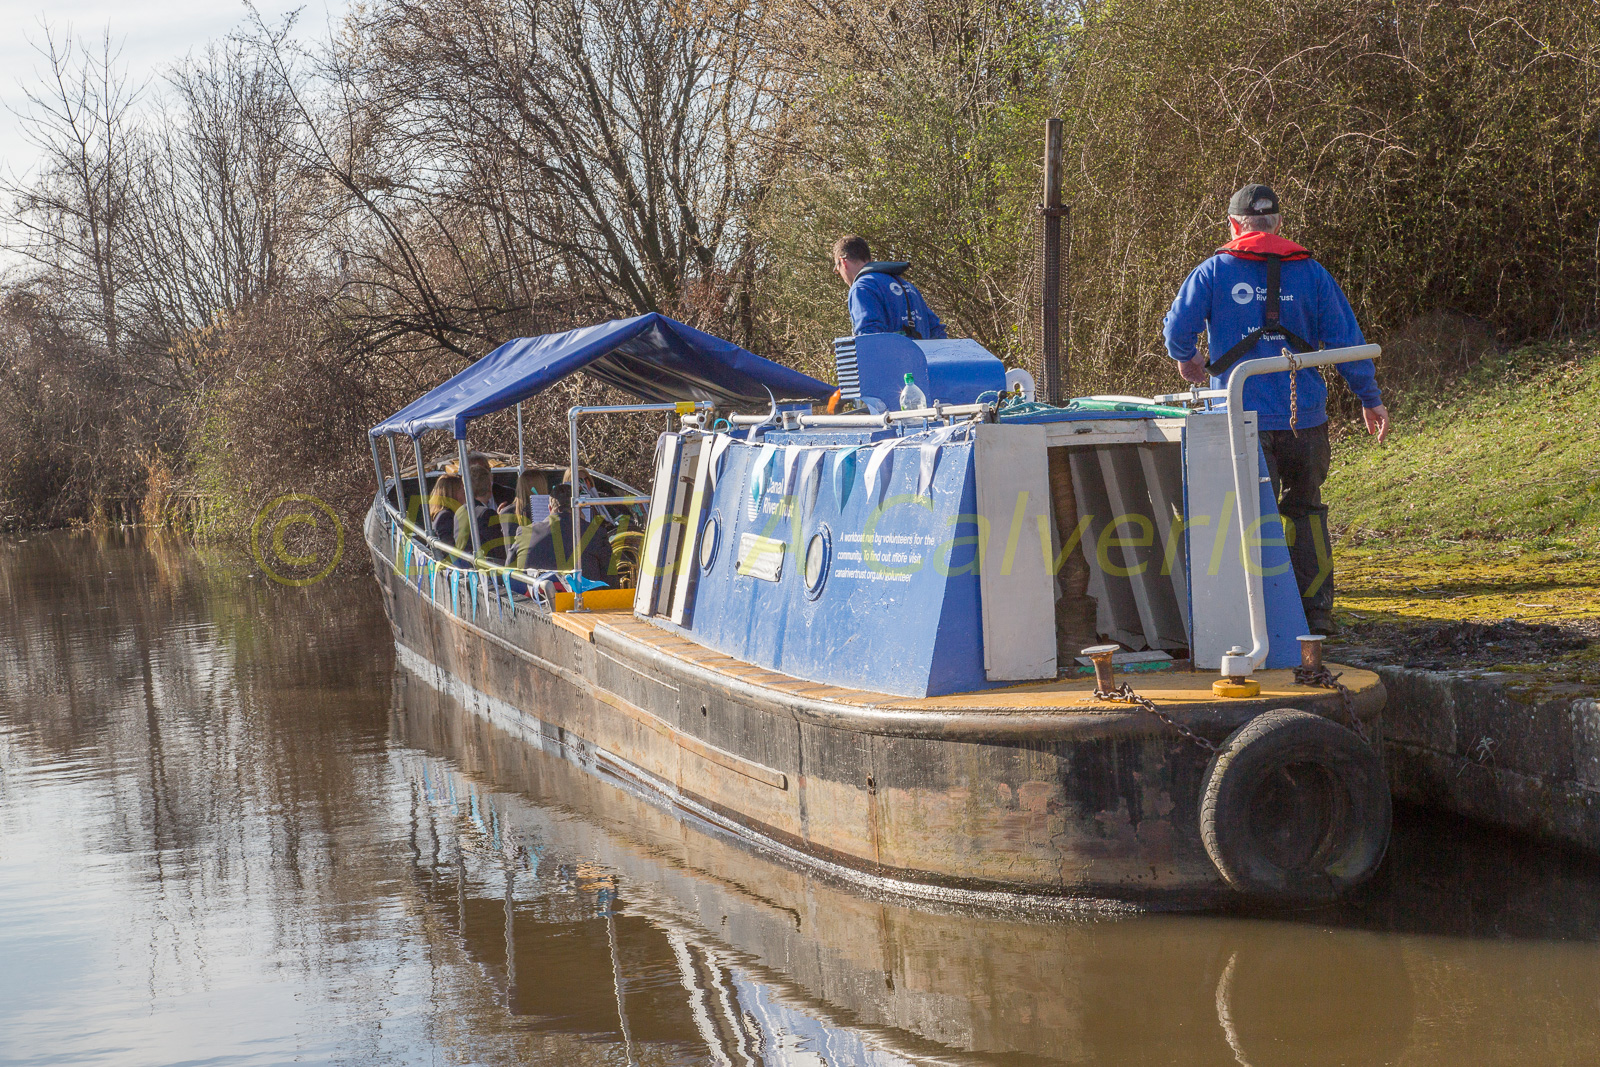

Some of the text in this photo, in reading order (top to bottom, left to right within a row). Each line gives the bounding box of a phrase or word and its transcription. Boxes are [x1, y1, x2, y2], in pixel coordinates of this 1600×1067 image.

[762, 497, 778, 515] River
[844, 532, 865, 543] workboat
[874, 532, 882, 546] by
[882, 532, 913, 545] volunteers
[913, 533, 924, 545] for
[924, 533, 935, 546] the
[863, 549, 870, 561] To
[870, 550, 881, 562] find
[881, 551, 892, 562] out
[891, 553, 908, 563] more
[908, 552, 922, 564] visit
